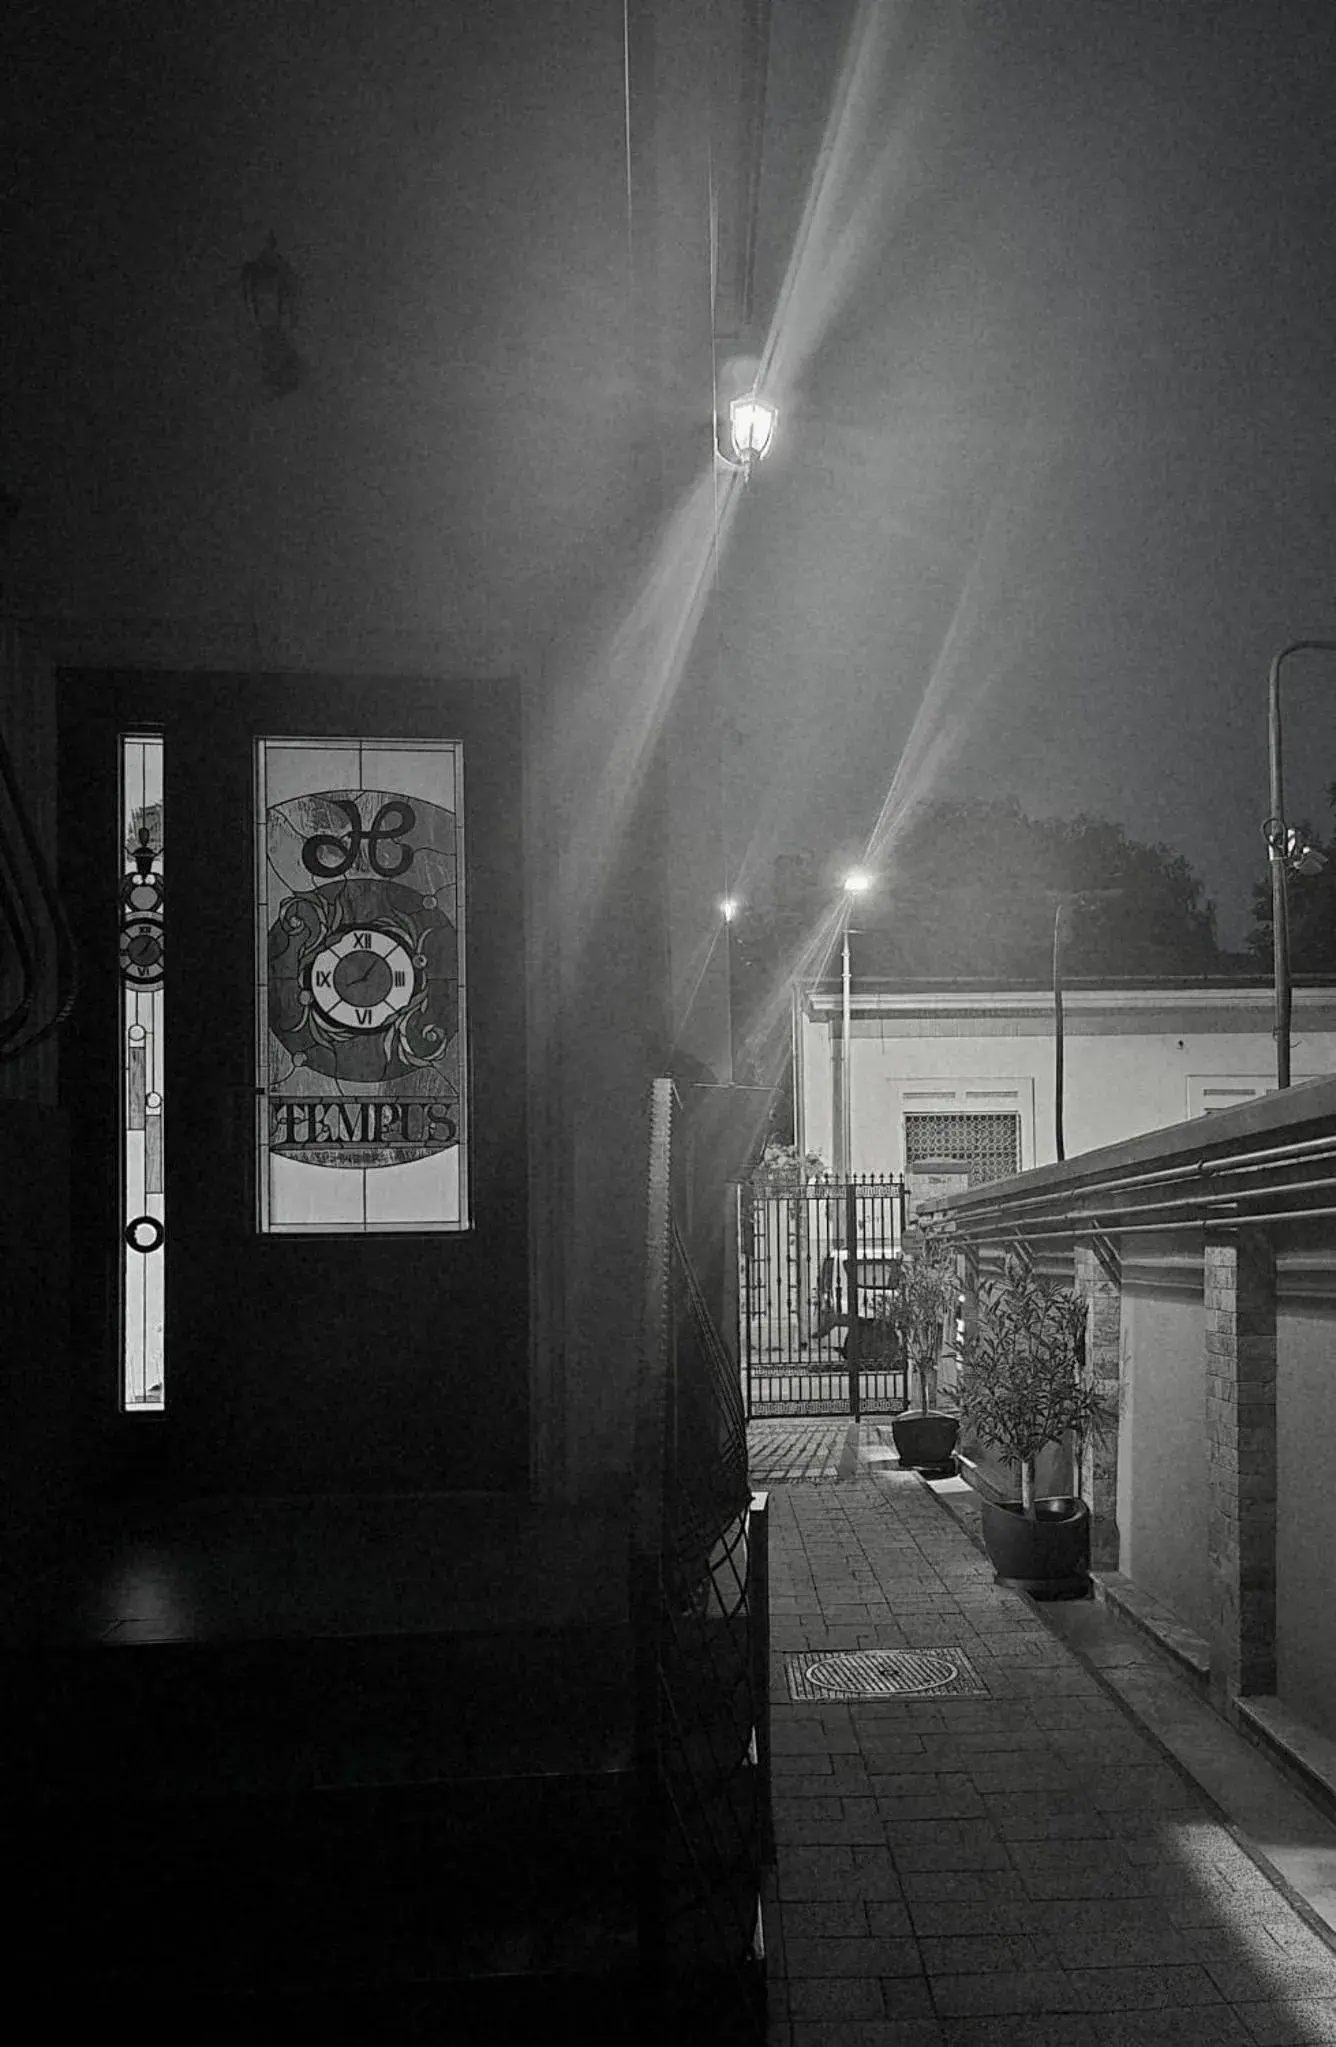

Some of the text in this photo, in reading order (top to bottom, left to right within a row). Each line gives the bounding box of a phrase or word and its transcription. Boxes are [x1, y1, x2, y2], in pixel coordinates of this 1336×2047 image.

[353, 932, 371, 949] XII
[316, 970, 331, 988] IX
[395, 970, 405, 988] III
[355, 1009, 372, 1025] VI
[272, 1103, 456, 1142] TEMPUS
